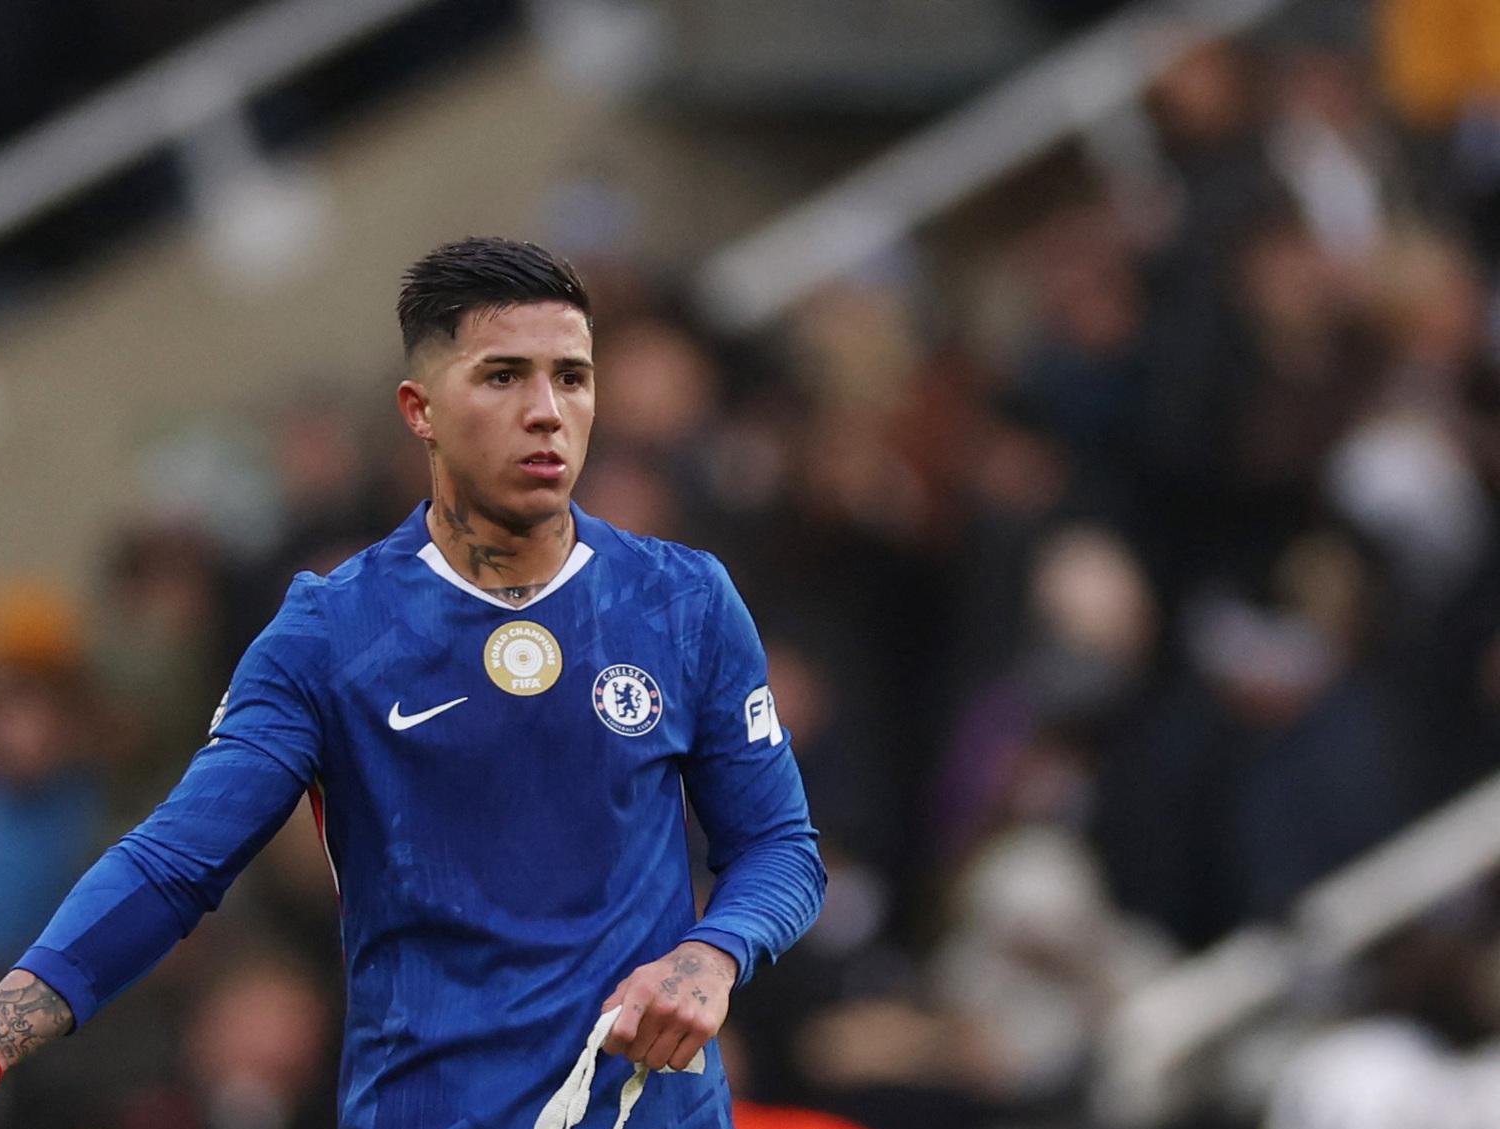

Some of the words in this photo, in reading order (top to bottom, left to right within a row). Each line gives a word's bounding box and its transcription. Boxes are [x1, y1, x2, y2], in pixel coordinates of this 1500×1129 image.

[491, 633, 509, 669] WORLD
[508, 627, 556, 666] CHAMPIONS
[511, 677, 542, 690] FIFA
[602, 667, 647, 684] CHELSEA
